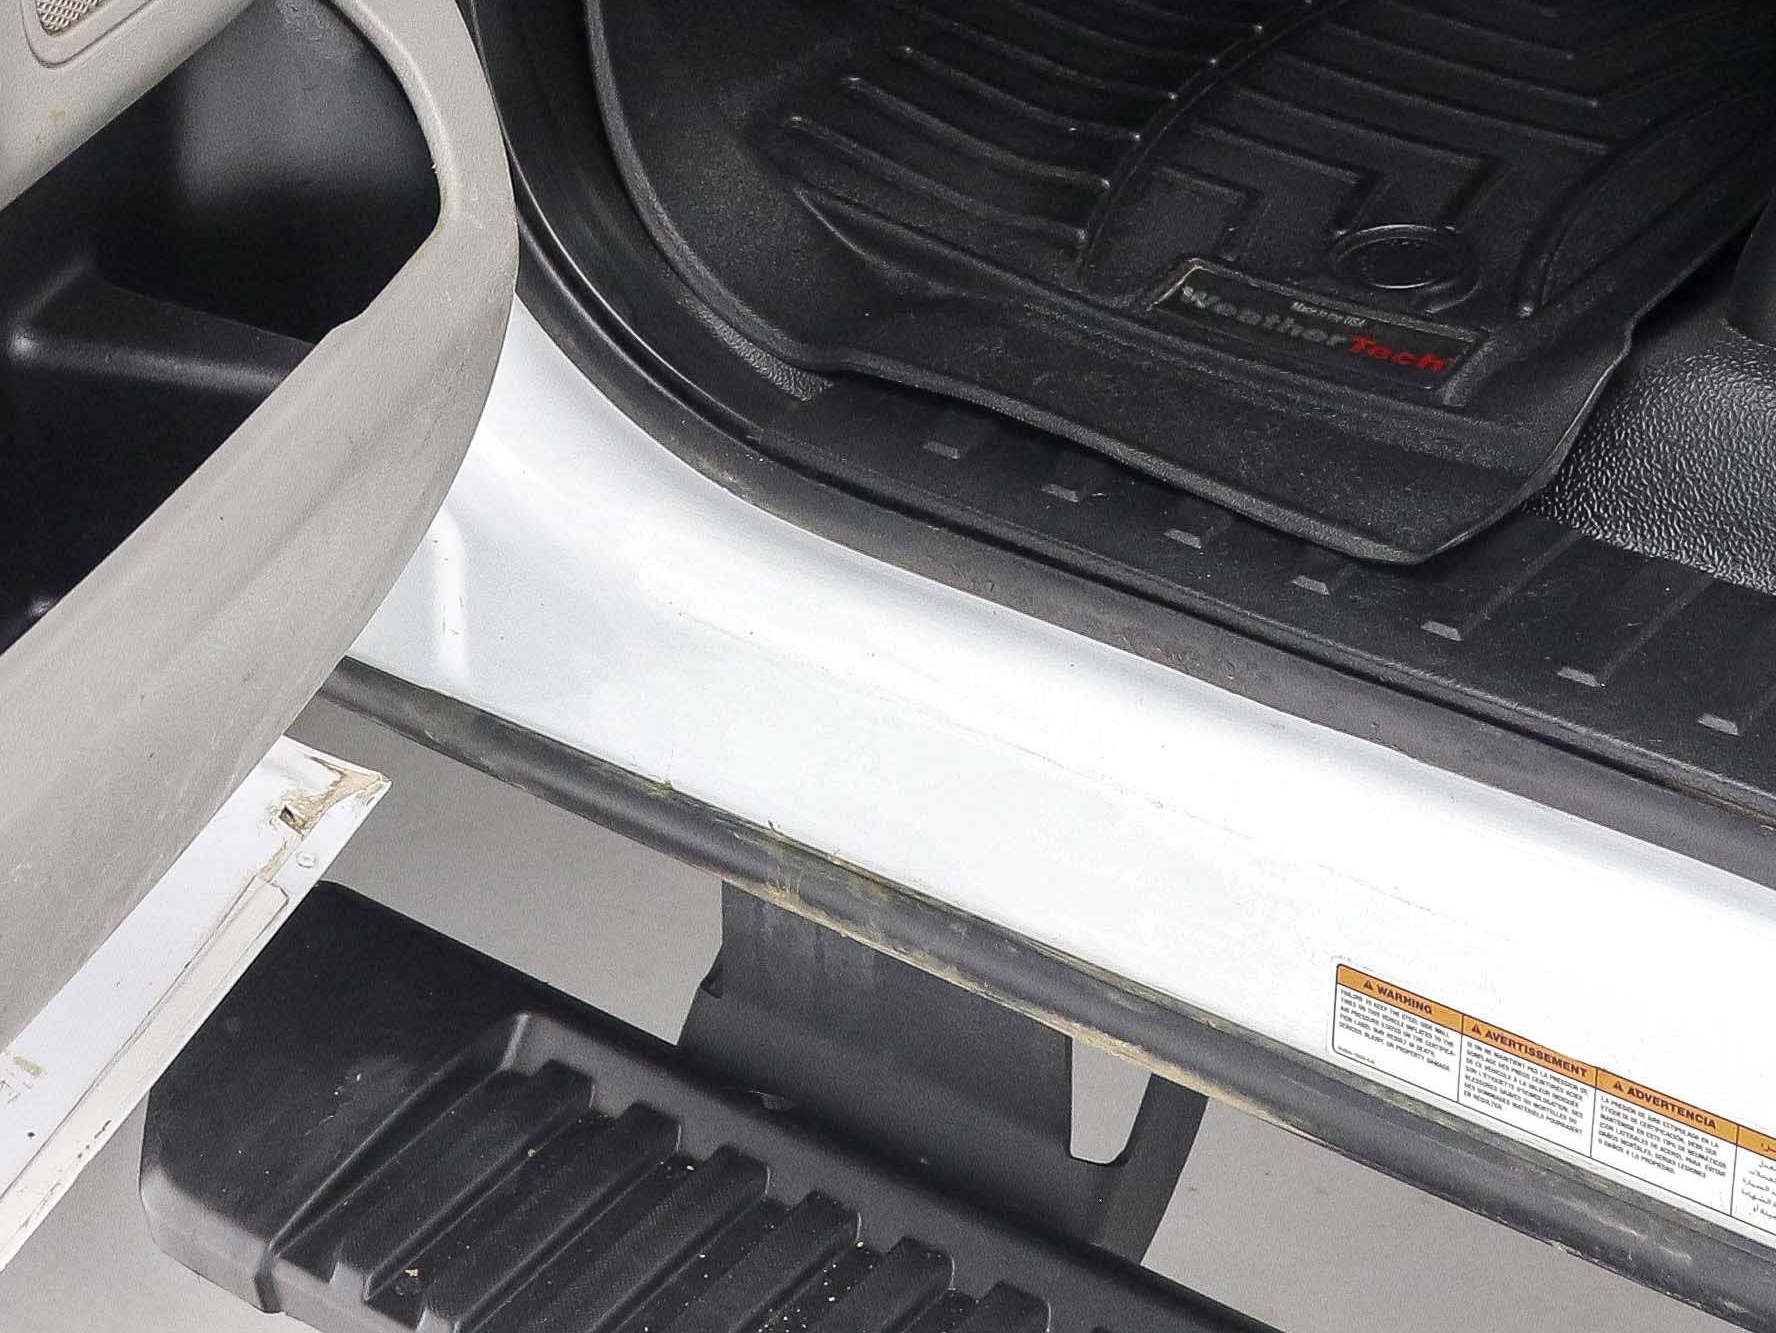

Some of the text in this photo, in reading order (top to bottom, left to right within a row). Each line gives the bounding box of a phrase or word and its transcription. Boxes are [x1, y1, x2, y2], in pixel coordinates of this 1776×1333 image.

[1377, 985, 1432, 1015] WARNING
[1485, 1029, 1587, 1077] AVERTISSEMENT
[1627, 1085, 1716, 1129] ADVERTENCIA
